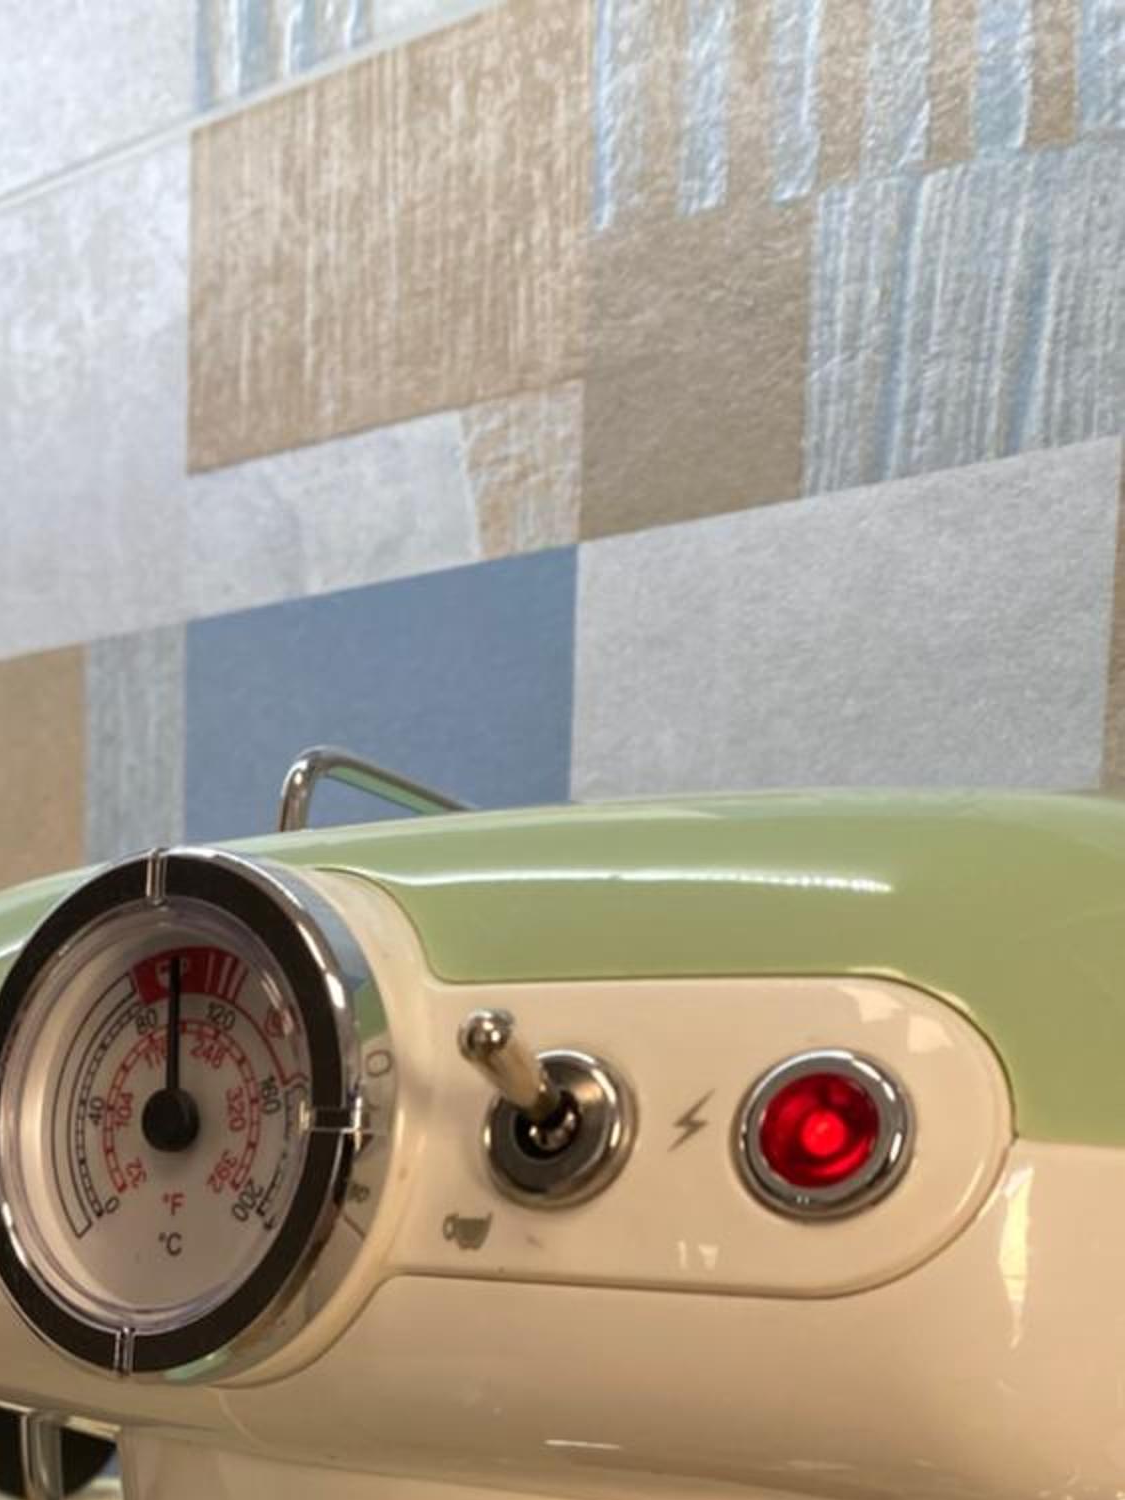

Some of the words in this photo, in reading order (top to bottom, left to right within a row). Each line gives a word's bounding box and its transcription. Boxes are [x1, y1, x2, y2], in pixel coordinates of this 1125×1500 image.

[135, 1005, 157, 1035] 80
[205, 1001, 236, 1032] 120
[189, 1037, 225, 1069] 248
[89, 1097, 105, 1126] 40
[112, 1092, 133, 1130] 104
[226, 1086, 246, 1132] 320
[206, 1149, 237, 1194] 392
[105, 1196, 119, 1214] 0
[231, 1178, 264, 1222] 200
